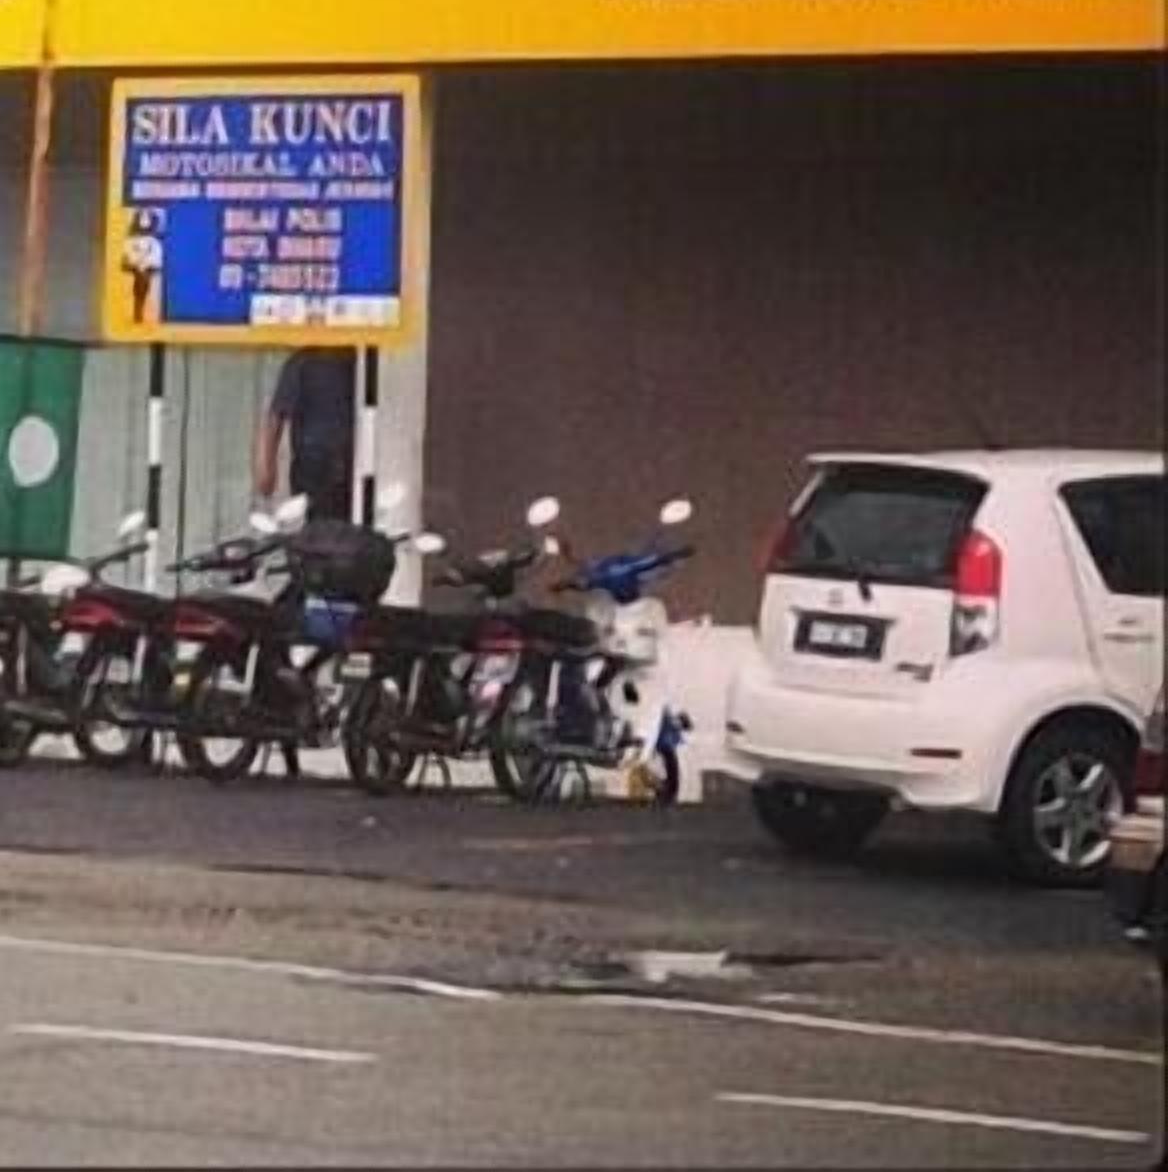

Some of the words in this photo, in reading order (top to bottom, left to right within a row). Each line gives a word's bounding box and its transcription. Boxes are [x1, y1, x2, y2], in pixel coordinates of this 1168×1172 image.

[133, 103, 230, 146] SILA
[249, 100, 392, 146] KUNCI
[139, 151, 298, 177] MOTOSIKAL
[307, 150, 386, 177] ANDA
